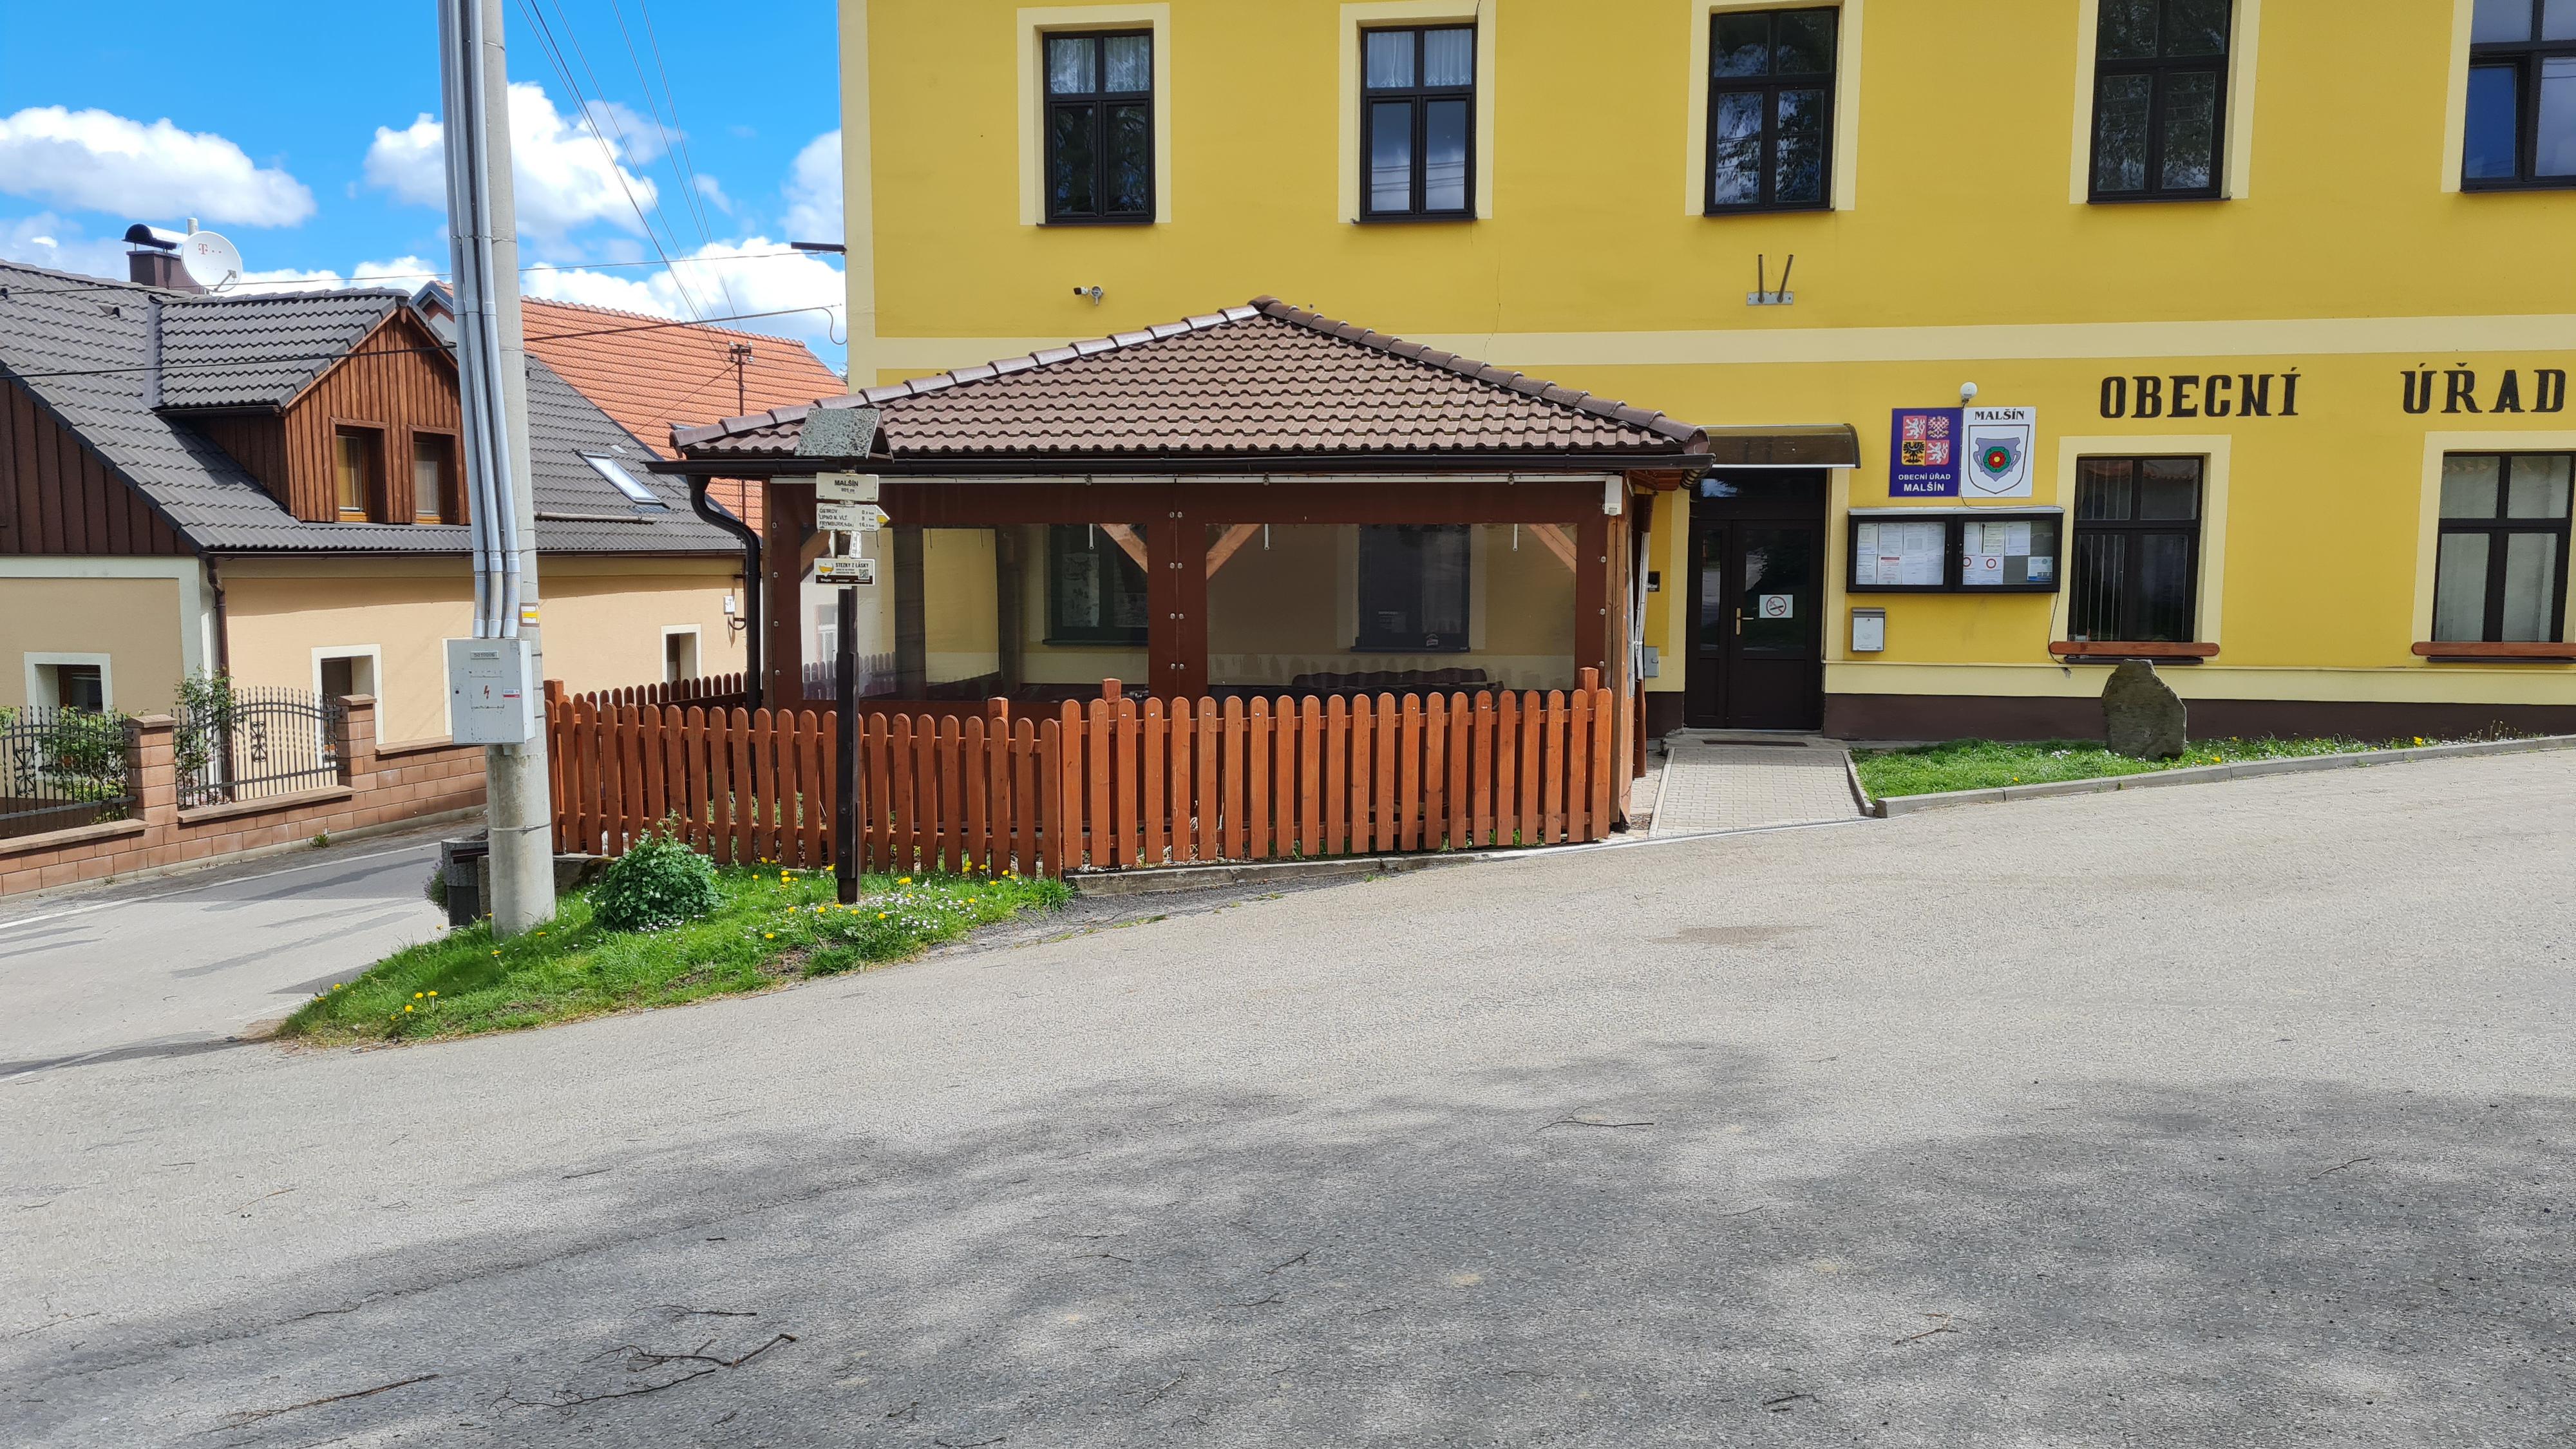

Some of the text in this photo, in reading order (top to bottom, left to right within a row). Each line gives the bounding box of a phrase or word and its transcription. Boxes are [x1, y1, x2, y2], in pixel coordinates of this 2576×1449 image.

[2099, 362, 2566, 419] OBECNÍ ÚŘAD
[1975, 408, 2025, 421] MALŠÍN
[1929, 472, 1951, 480] ÚŘAD
[1904, 481, 1944, 491] MALŠÍN
